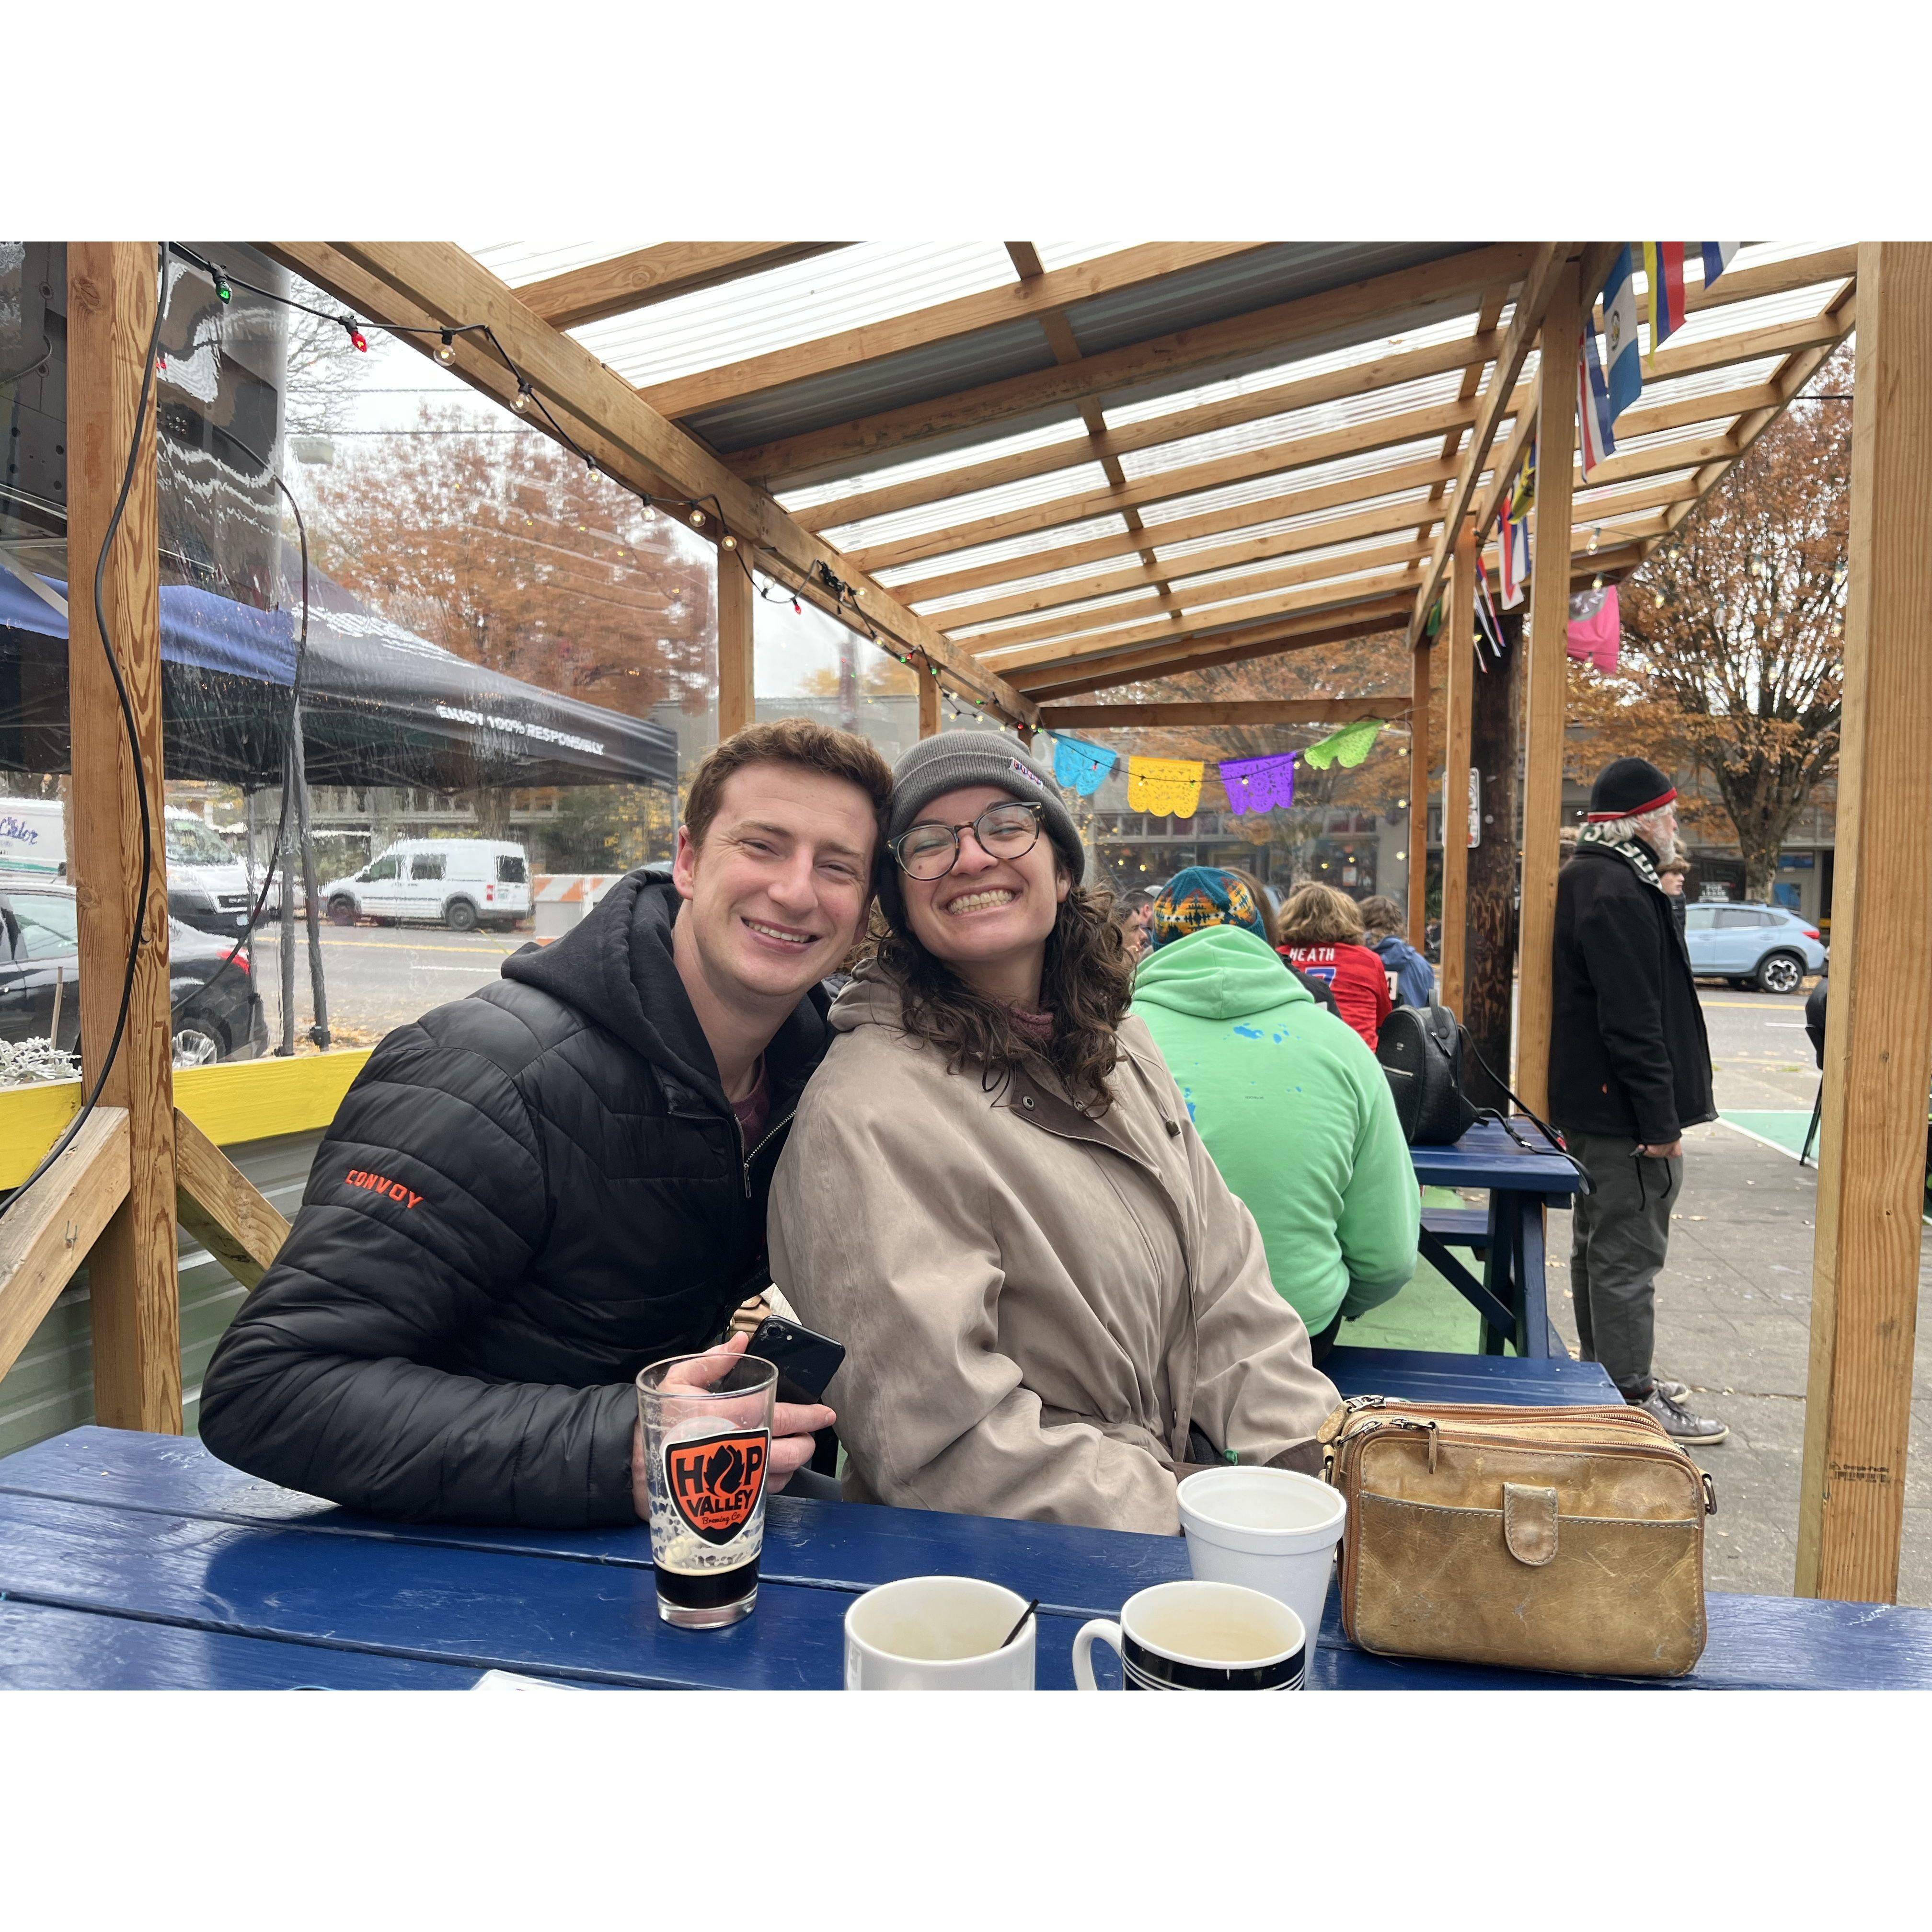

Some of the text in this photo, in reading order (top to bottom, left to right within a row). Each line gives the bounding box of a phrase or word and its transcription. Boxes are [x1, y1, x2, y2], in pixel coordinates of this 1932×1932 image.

[487, 716, 525, 735] 100%
[1289, 947, 1335, 962] HEATH
[345, 1169, 424, 1209] CONVOY
[676, 1444, 763, 1497] HOP
[686, 1488, 754, 1518] VALLEY
[702, 1516, 730, 1525] Brewing
